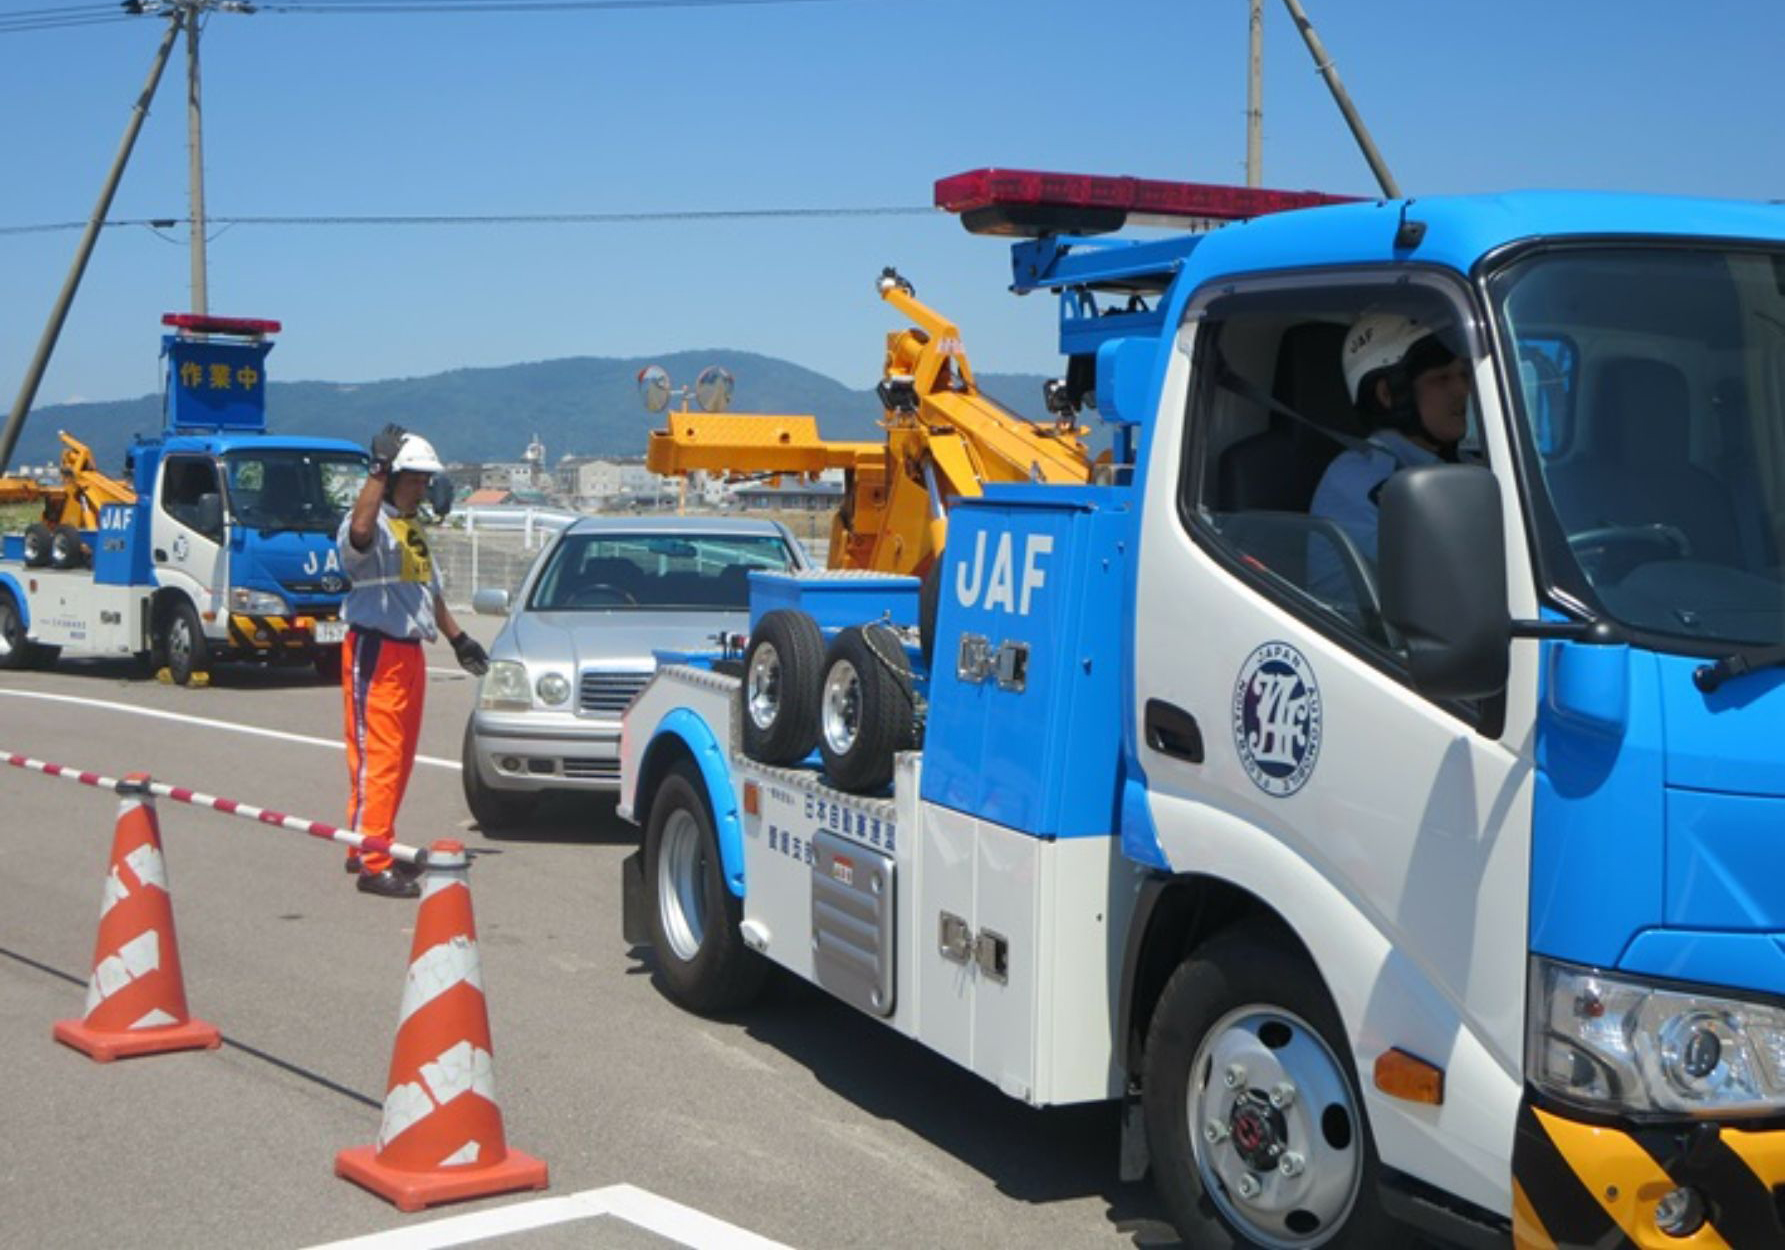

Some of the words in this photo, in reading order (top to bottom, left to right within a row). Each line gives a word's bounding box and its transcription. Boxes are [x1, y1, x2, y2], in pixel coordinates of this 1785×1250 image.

[181, 361, 257, 391] 作業中
[102, 508, 133, 530] JAF
[303, 548, 340, 575] JA
[957, 530, 1054, 615] JAF
